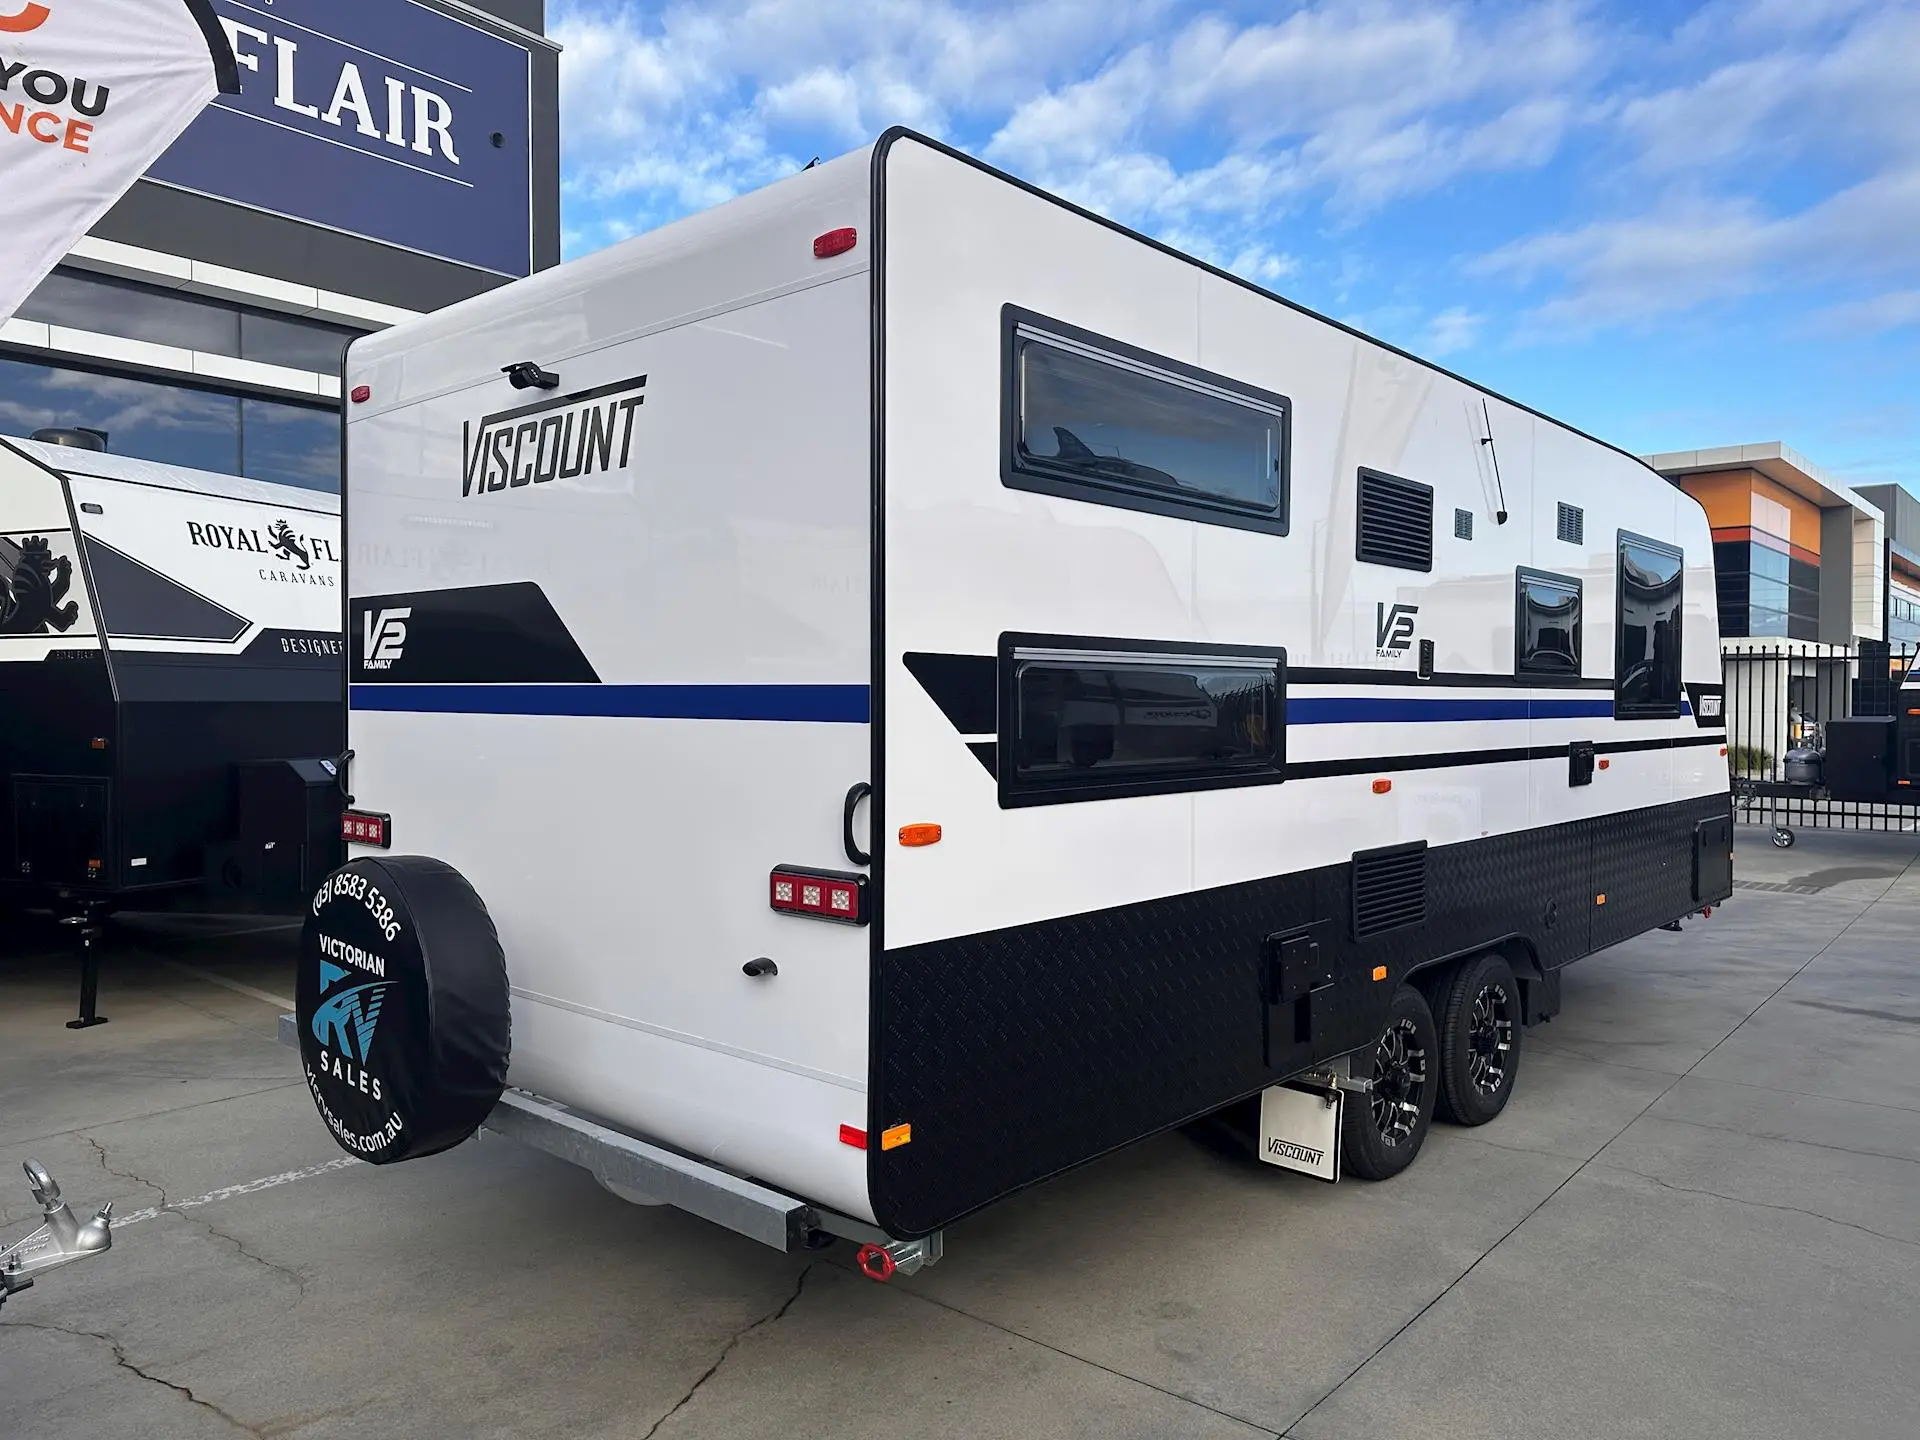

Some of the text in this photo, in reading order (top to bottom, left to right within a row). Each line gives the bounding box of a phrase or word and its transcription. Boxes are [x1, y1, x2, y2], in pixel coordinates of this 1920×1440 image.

[0, 57, 110, 117] YOU
[215, 15, 460, 165] FLAIR
[0, 103, 94, 154] NCE
[463, 374, 648, 498] VISCOUNT
[186, 521, 342, 562] ROYAL FL
[259, 569, 335, 587] CARAVANS
[362, 658, 392, 670] FAMILY
[1376, 649, 1402, 658] FAMILY
[334, 874, 367, 900] 8583
[365, 887, 401, 941] 5386
[319, 933, 385, 977] VICTORIAN
[321, 1050, 382, 1100] SALES
[1267, 1136, 1325, 1166] VISCOUNT
